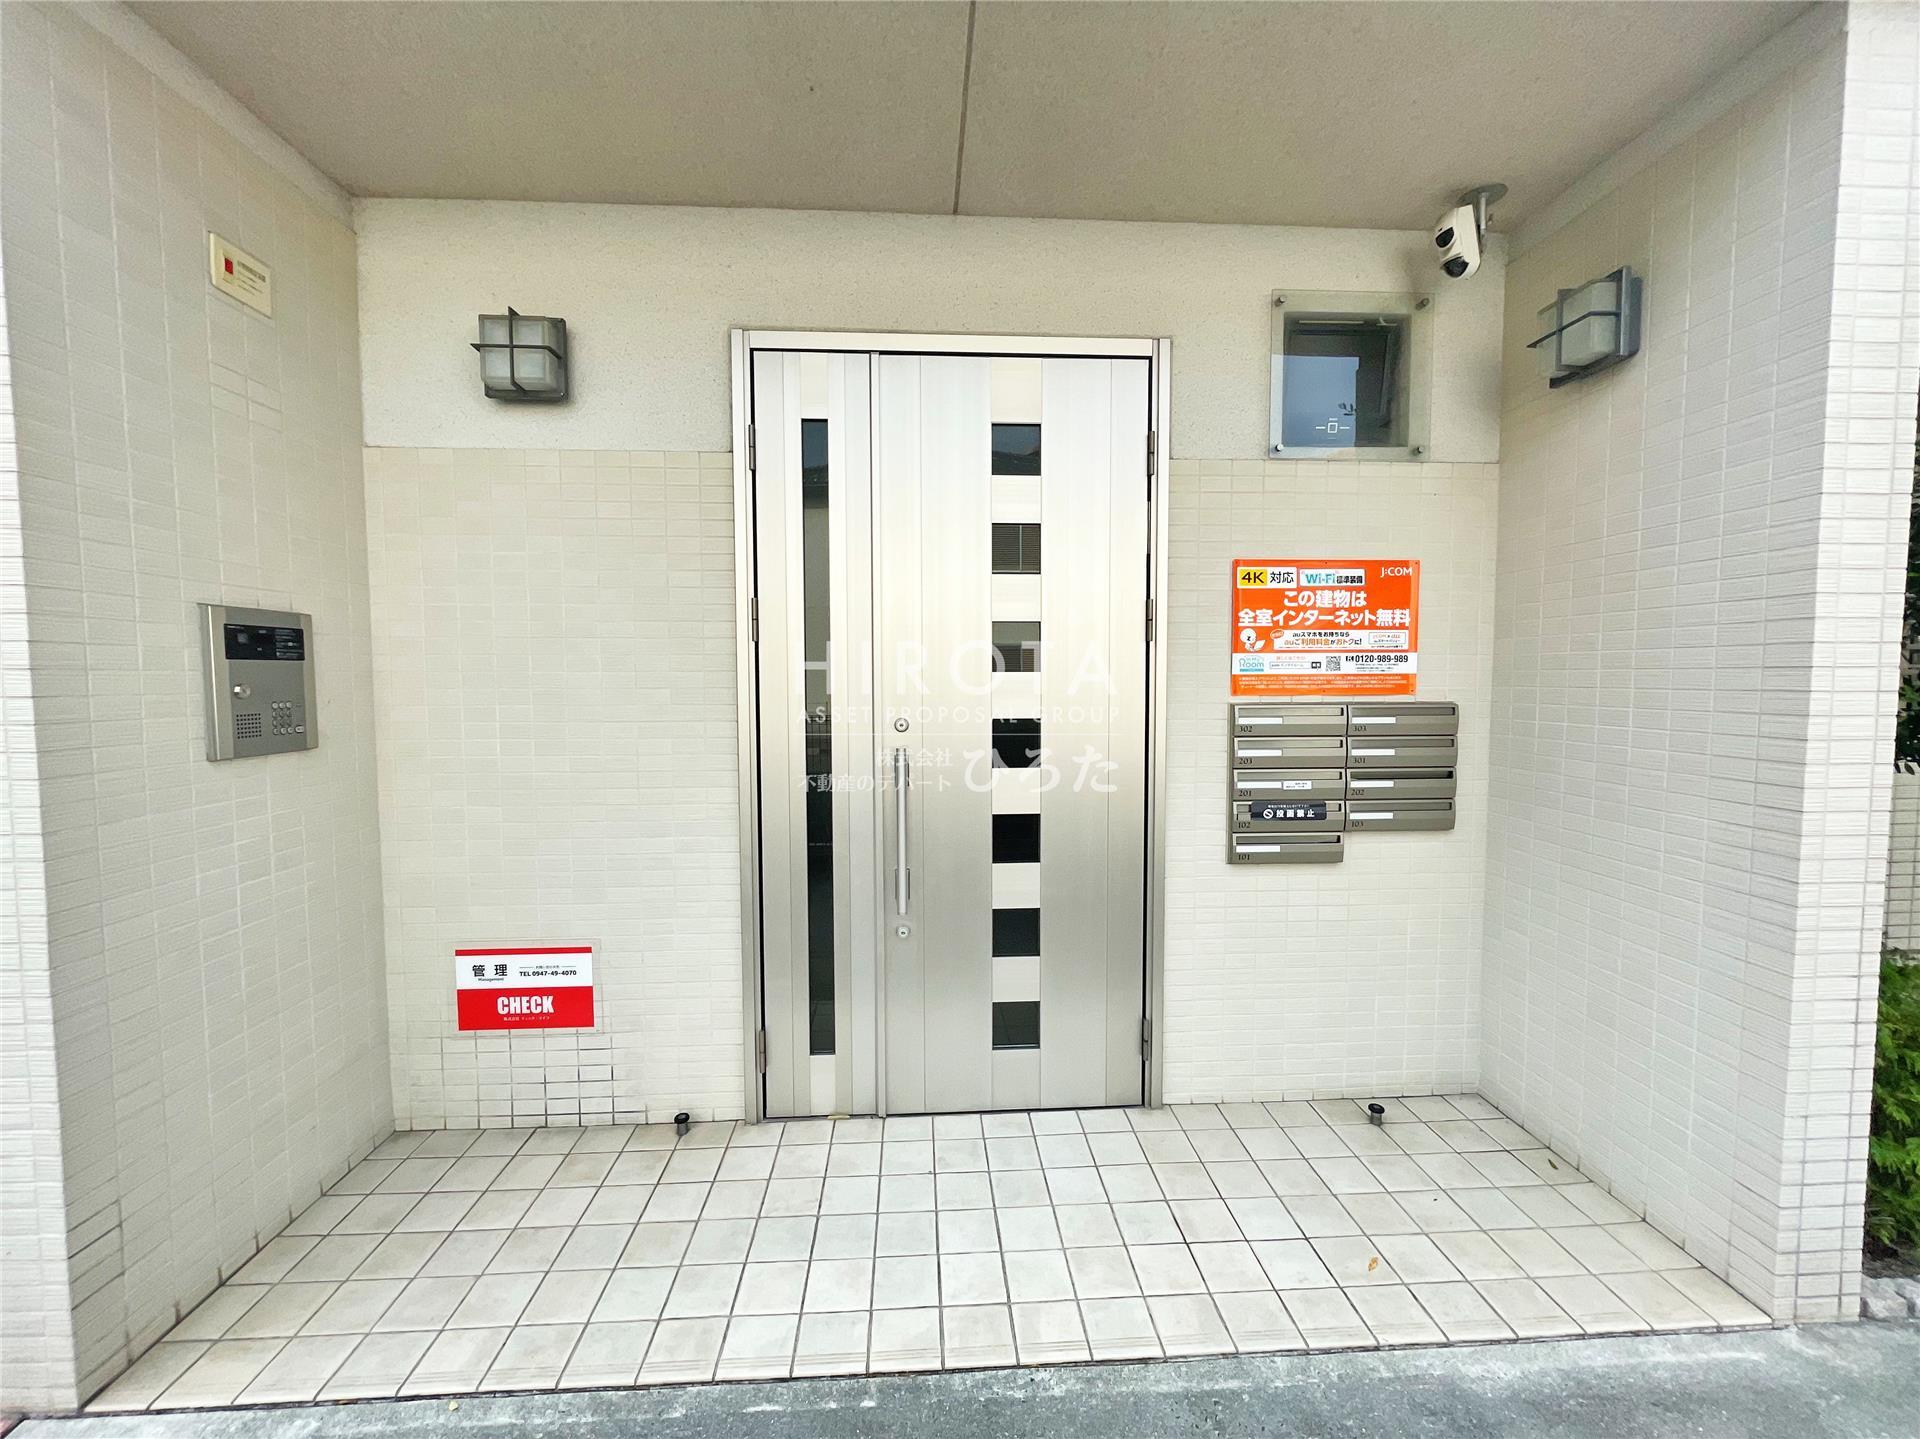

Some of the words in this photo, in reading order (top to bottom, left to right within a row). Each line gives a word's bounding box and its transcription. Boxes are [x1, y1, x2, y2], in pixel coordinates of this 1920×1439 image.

[1241, 571, 1265, 584] 4K
[1269, 571, 1294, 584] 対応
[1380, 567, 1412, 578] J:COM
[1305, 572, 1336, 585] Wi-Fi
[1283, 589, 1367, 608] この建物は
[1237, 608, 1411, 627] 全室インターネット無料
[1239, 657, 1264, 668] Room
[1238, 789, 1252, 797] 201
[1350, 788, 1365, 796] 202
[1276, 808, 1315, 818] 投函禁止
[1237, 821, 1251, 829] 102
[1237, 853, 1251, 861] 101
[472, 964, 508, 978] 管理
[497, 995, 555, 1015] CHECK
